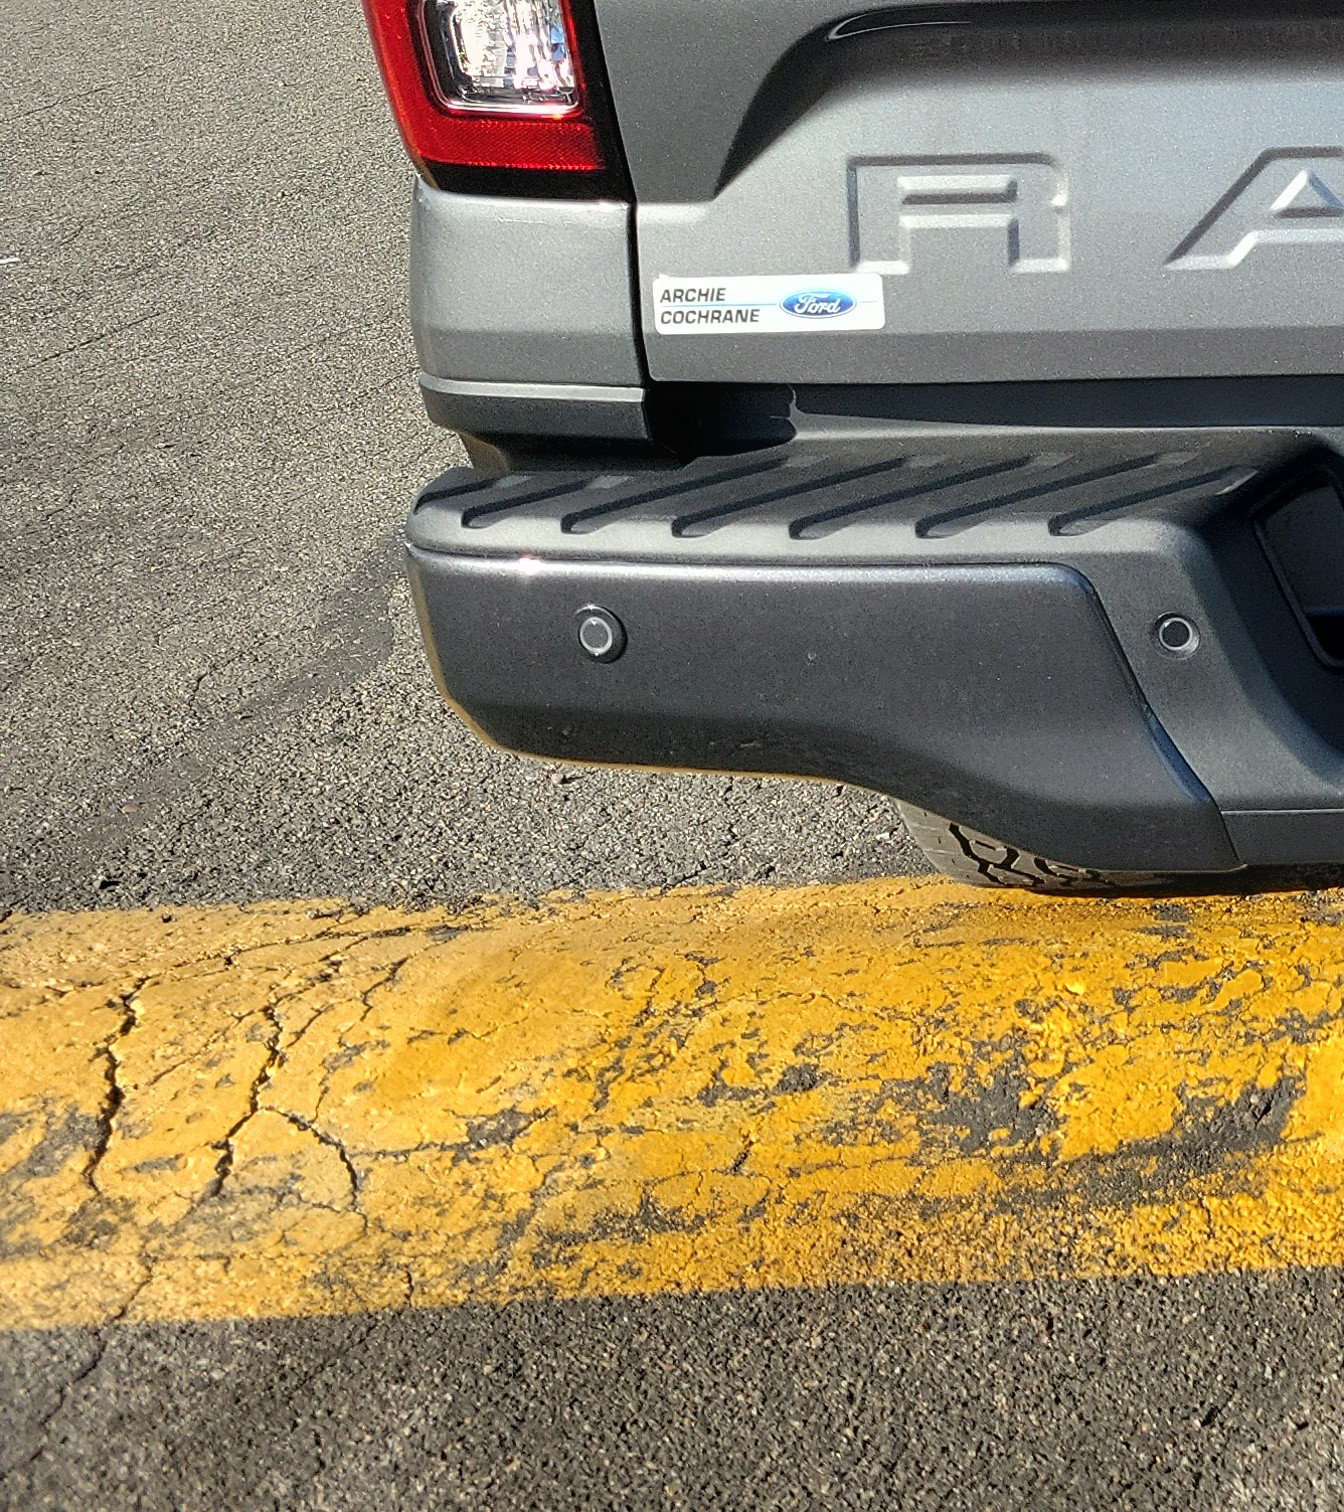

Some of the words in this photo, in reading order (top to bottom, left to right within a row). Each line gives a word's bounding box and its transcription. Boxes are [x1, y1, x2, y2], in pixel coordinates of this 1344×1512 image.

[660, 288, 726, 303] ARCHIE
[793, 291, 841, 314] Ford
[660, 309, 760, 325] COCHRANE
